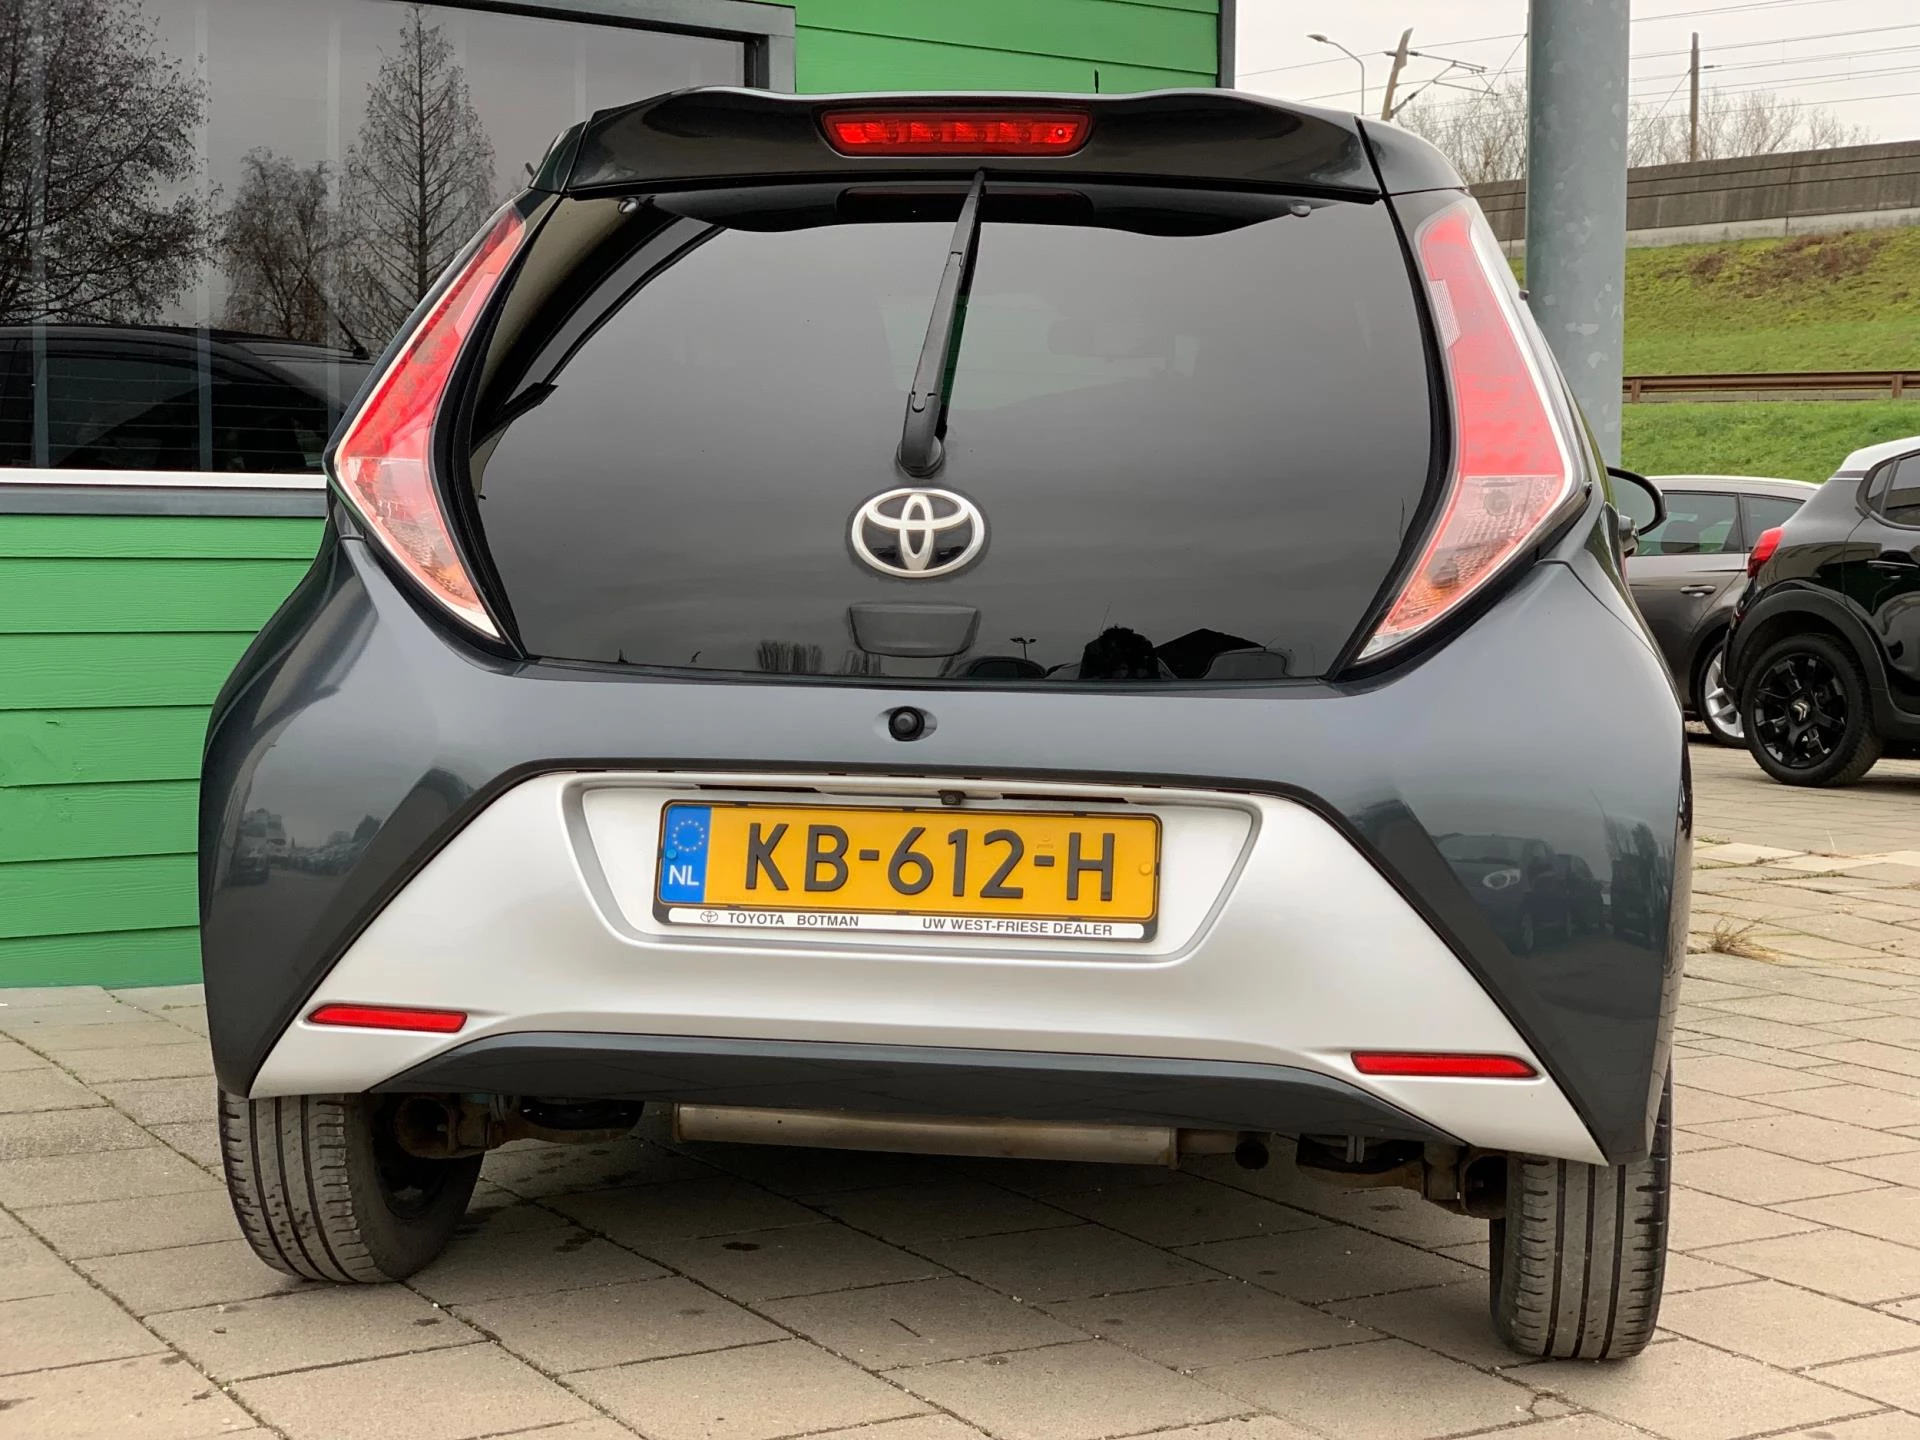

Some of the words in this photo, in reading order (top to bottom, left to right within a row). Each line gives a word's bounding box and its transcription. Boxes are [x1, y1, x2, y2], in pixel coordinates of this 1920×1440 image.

[745, 822, 1116, 902] KB-612-H
[668, 865, 699, 886] NL
[728, 912, 785, 925] TOYOTA
[797, 914, 859, 927] BOTMAN
[922, 918, 946, 929] UW
[950, 919, 1049, 933] WEST-FRIESE
[1053, 923, 1113, 936] DEALER
